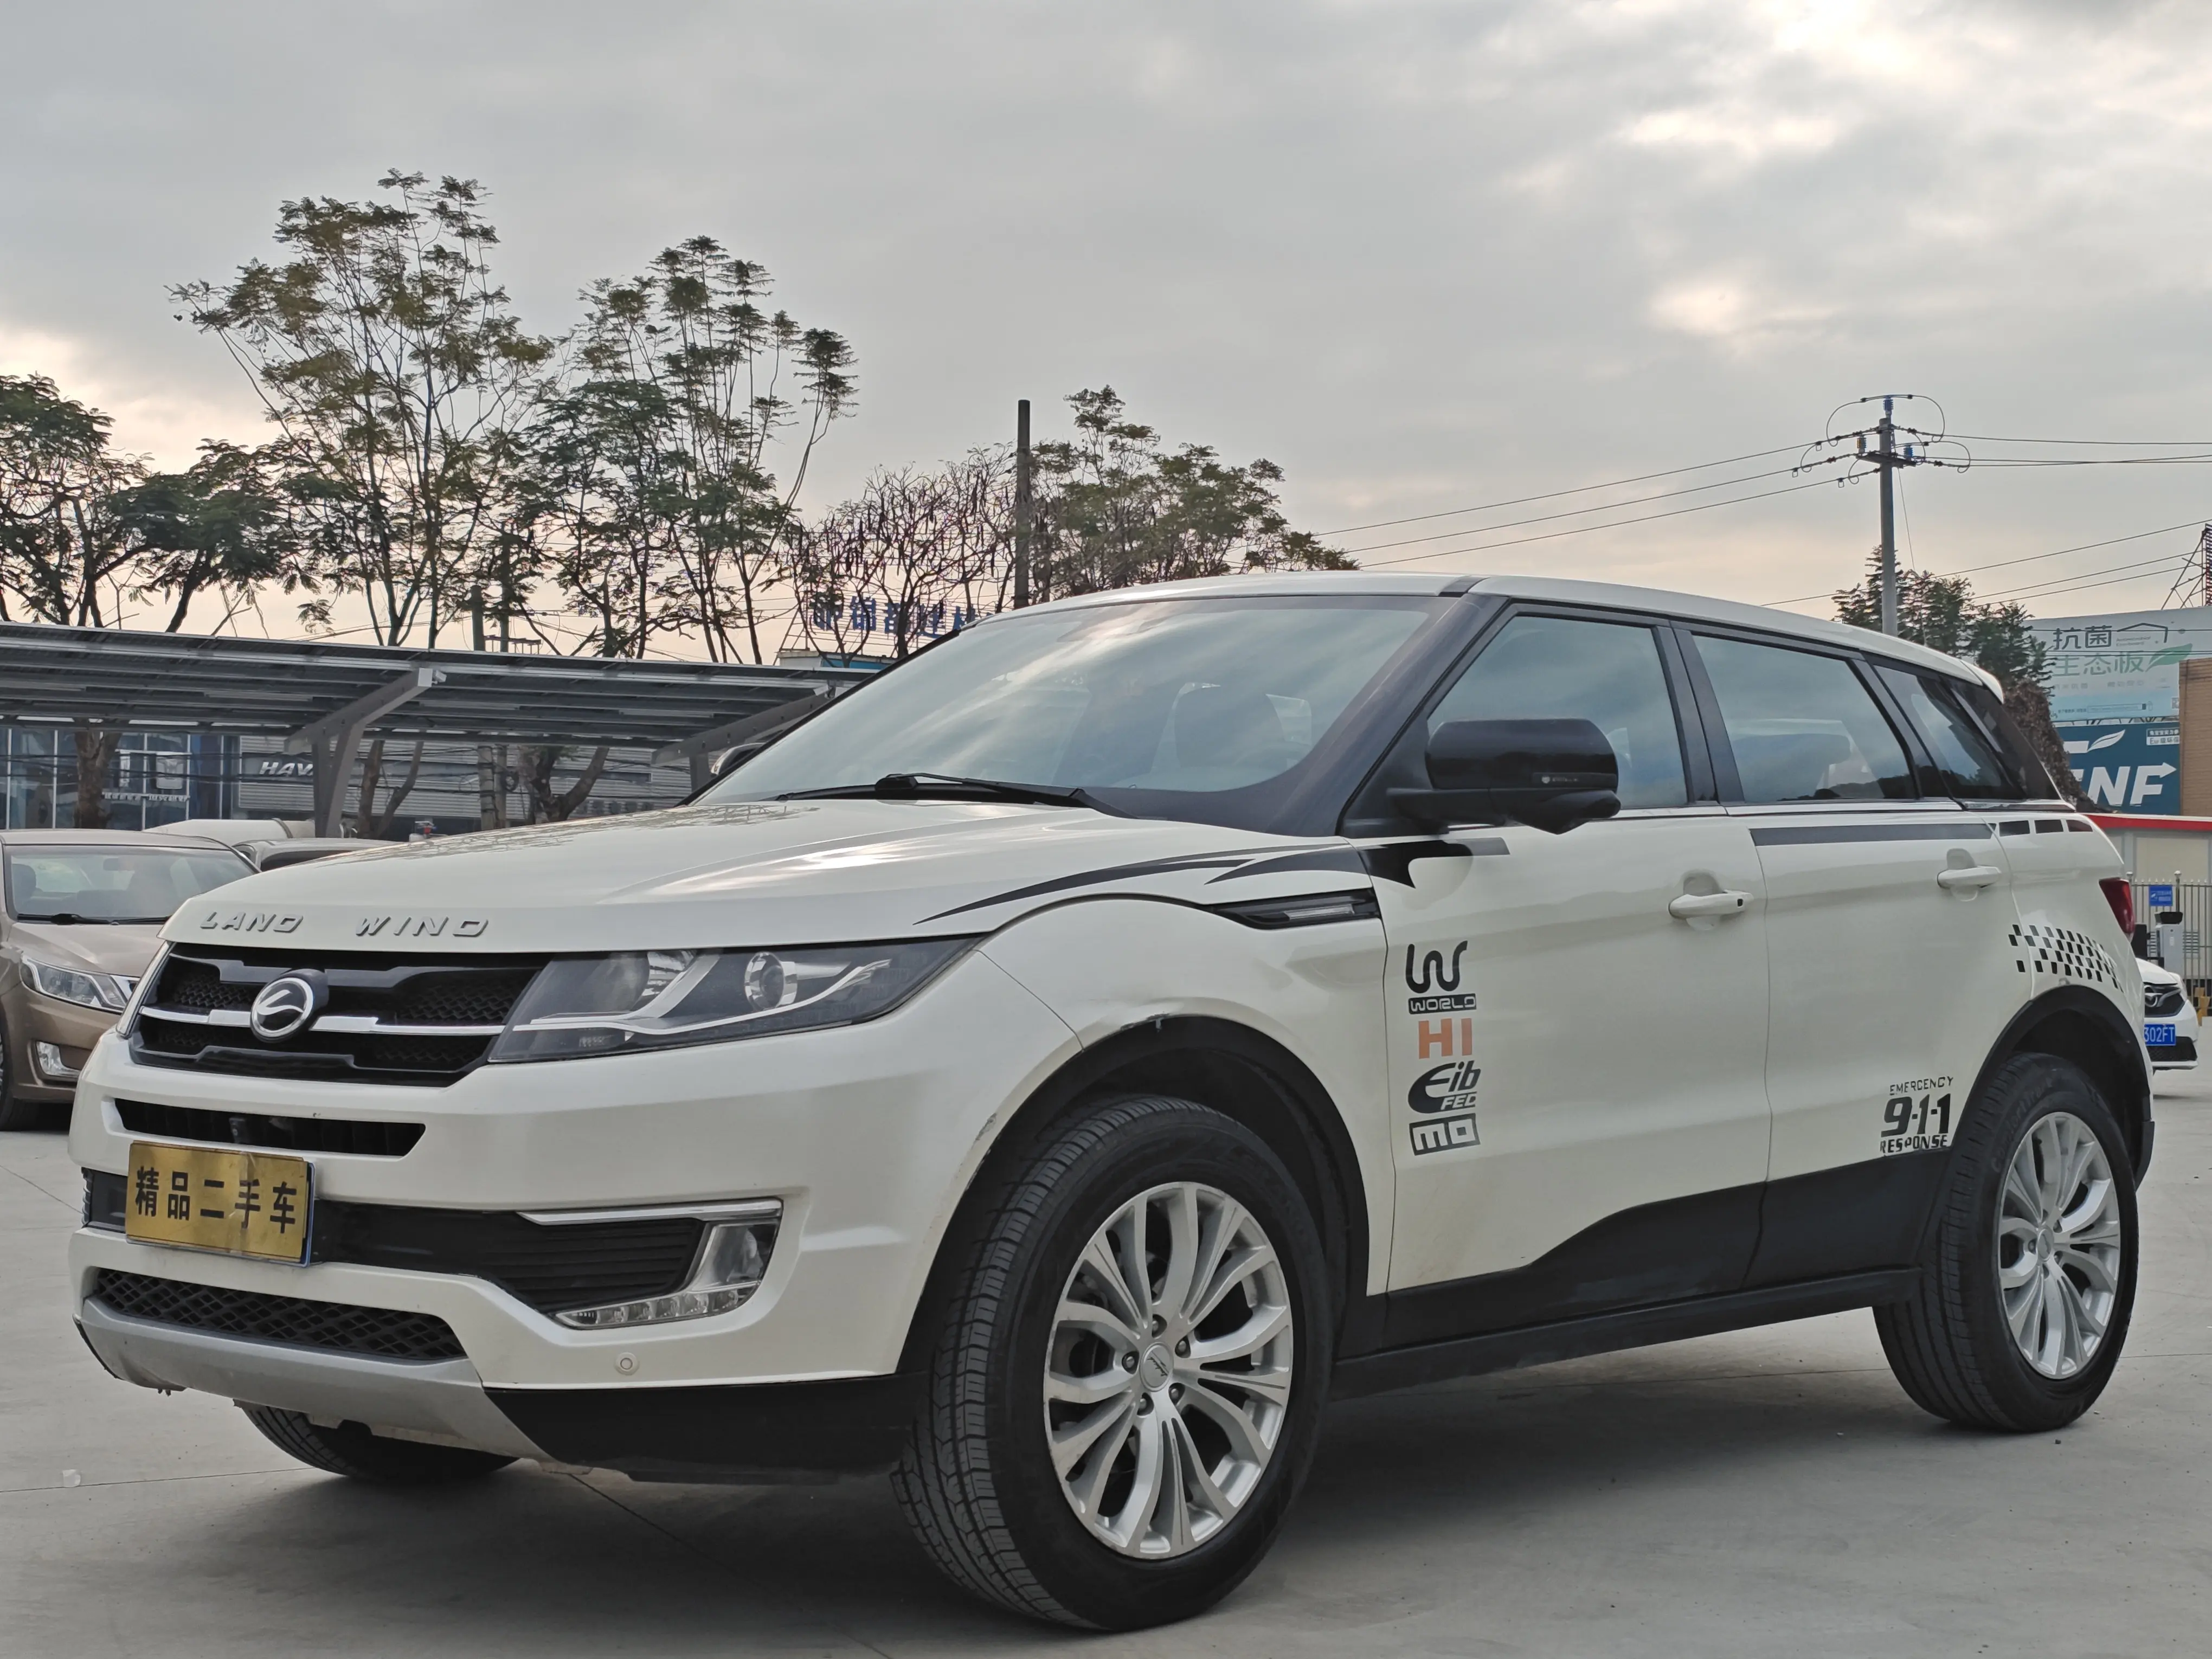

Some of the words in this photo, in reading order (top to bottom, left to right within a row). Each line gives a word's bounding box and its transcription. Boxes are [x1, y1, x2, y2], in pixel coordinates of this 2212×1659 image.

[2053, 625, 2112, 651] 抗菌
[2052, 651, 2145, 677] 生态板
[259, 761, 314, 776] HAV
[200, 911, 304, 934] LAND
[355, 916, 489, 937] WIND
[1410, 994, 1477, 1013] WORLD
[1418, 1018, 1472, 1059] HI
[2143, 1026, 2175, 1042] 302FT
[1880, 1134, 1948, 1154] RESPONSE
[135, 1166, 298, 1234] 精品二手车
